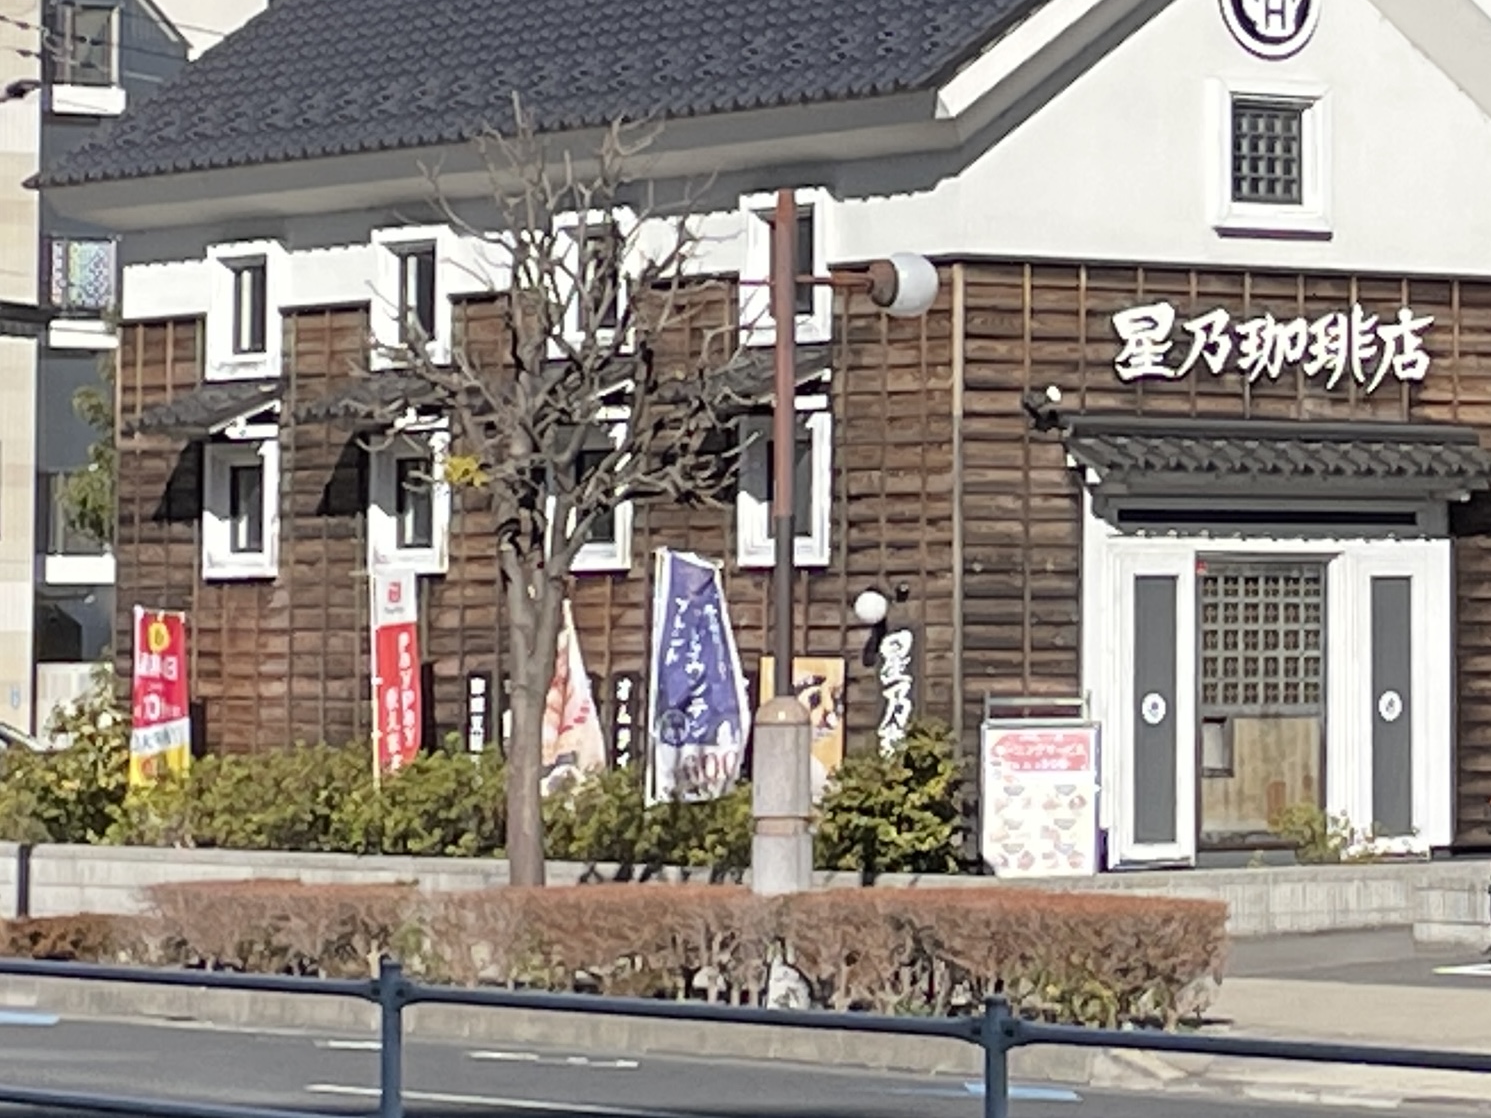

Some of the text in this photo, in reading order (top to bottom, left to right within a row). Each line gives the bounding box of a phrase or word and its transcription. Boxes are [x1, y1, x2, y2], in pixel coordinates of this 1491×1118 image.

[1111, 300, 1435, 394] 星乃珈琲店
